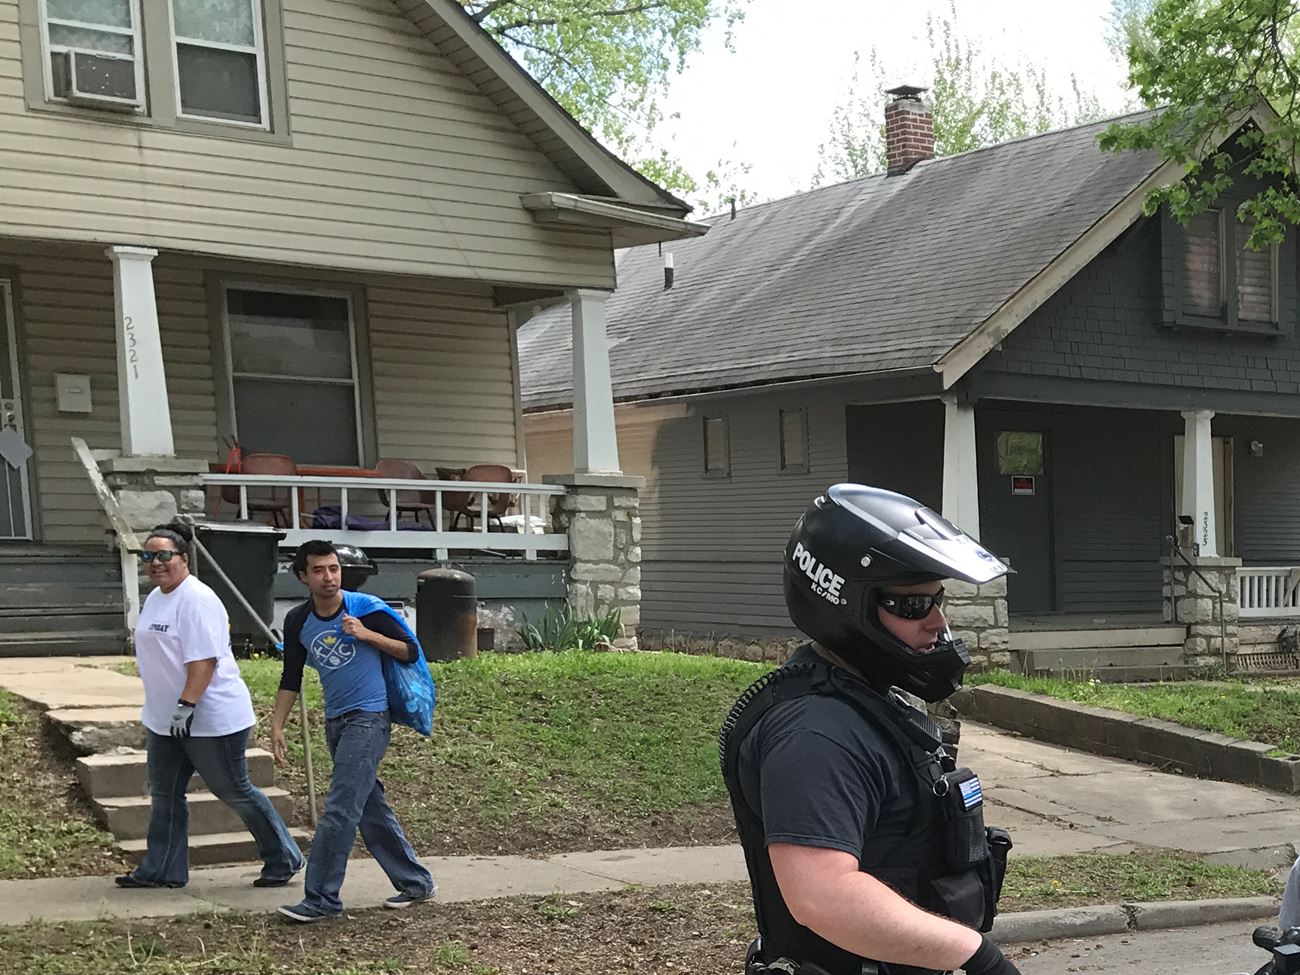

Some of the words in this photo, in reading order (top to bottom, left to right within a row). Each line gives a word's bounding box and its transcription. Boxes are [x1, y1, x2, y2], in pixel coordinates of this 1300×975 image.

[124, 316, 139, 380] 2321
[792, 541, 846, 597] POLICE
[811, 582, 841, 605] KC/MO
